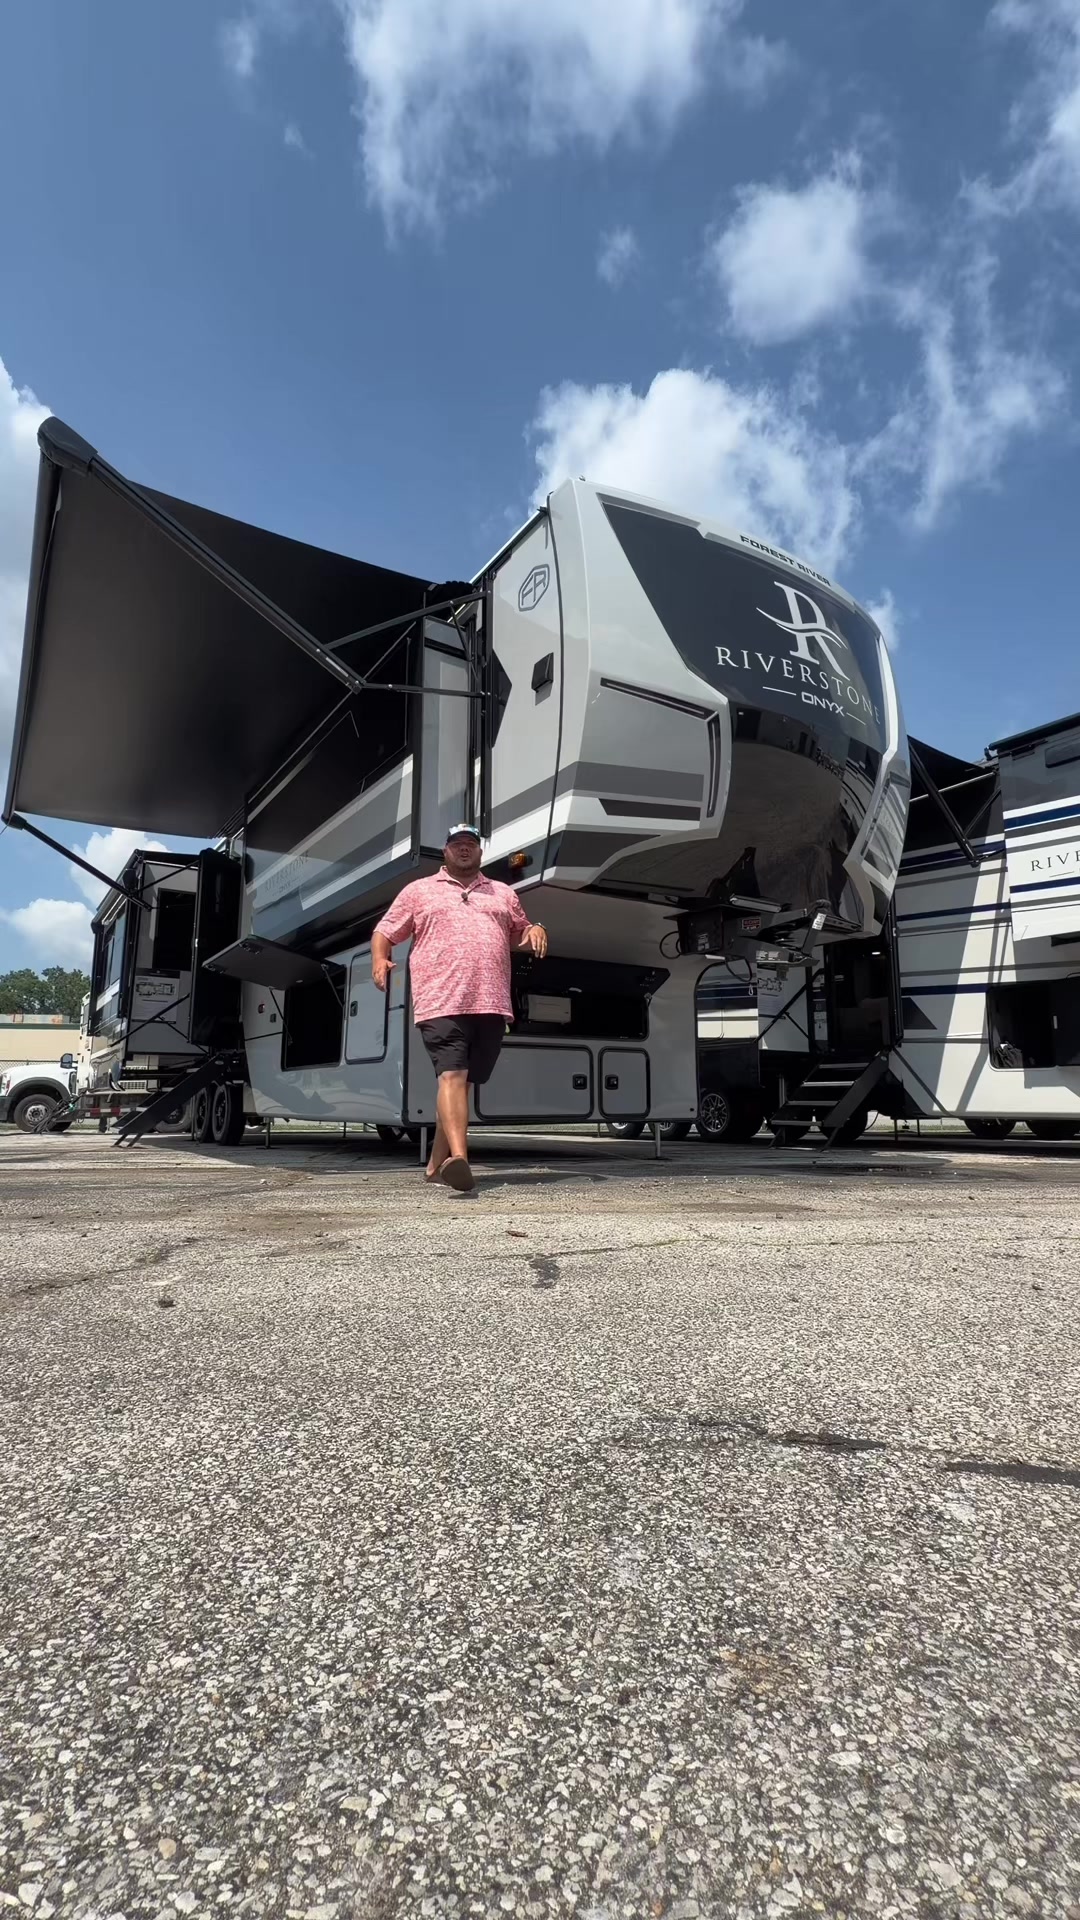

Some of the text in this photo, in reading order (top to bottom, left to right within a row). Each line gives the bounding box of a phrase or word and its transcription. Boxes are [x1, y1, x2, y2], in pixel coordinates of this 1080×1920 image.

[740, 535, 831, 587] FOREST RIVER
[715, 646, 881, 725] RIVERSTONE
[801, 691, 845, 717] ONYX
